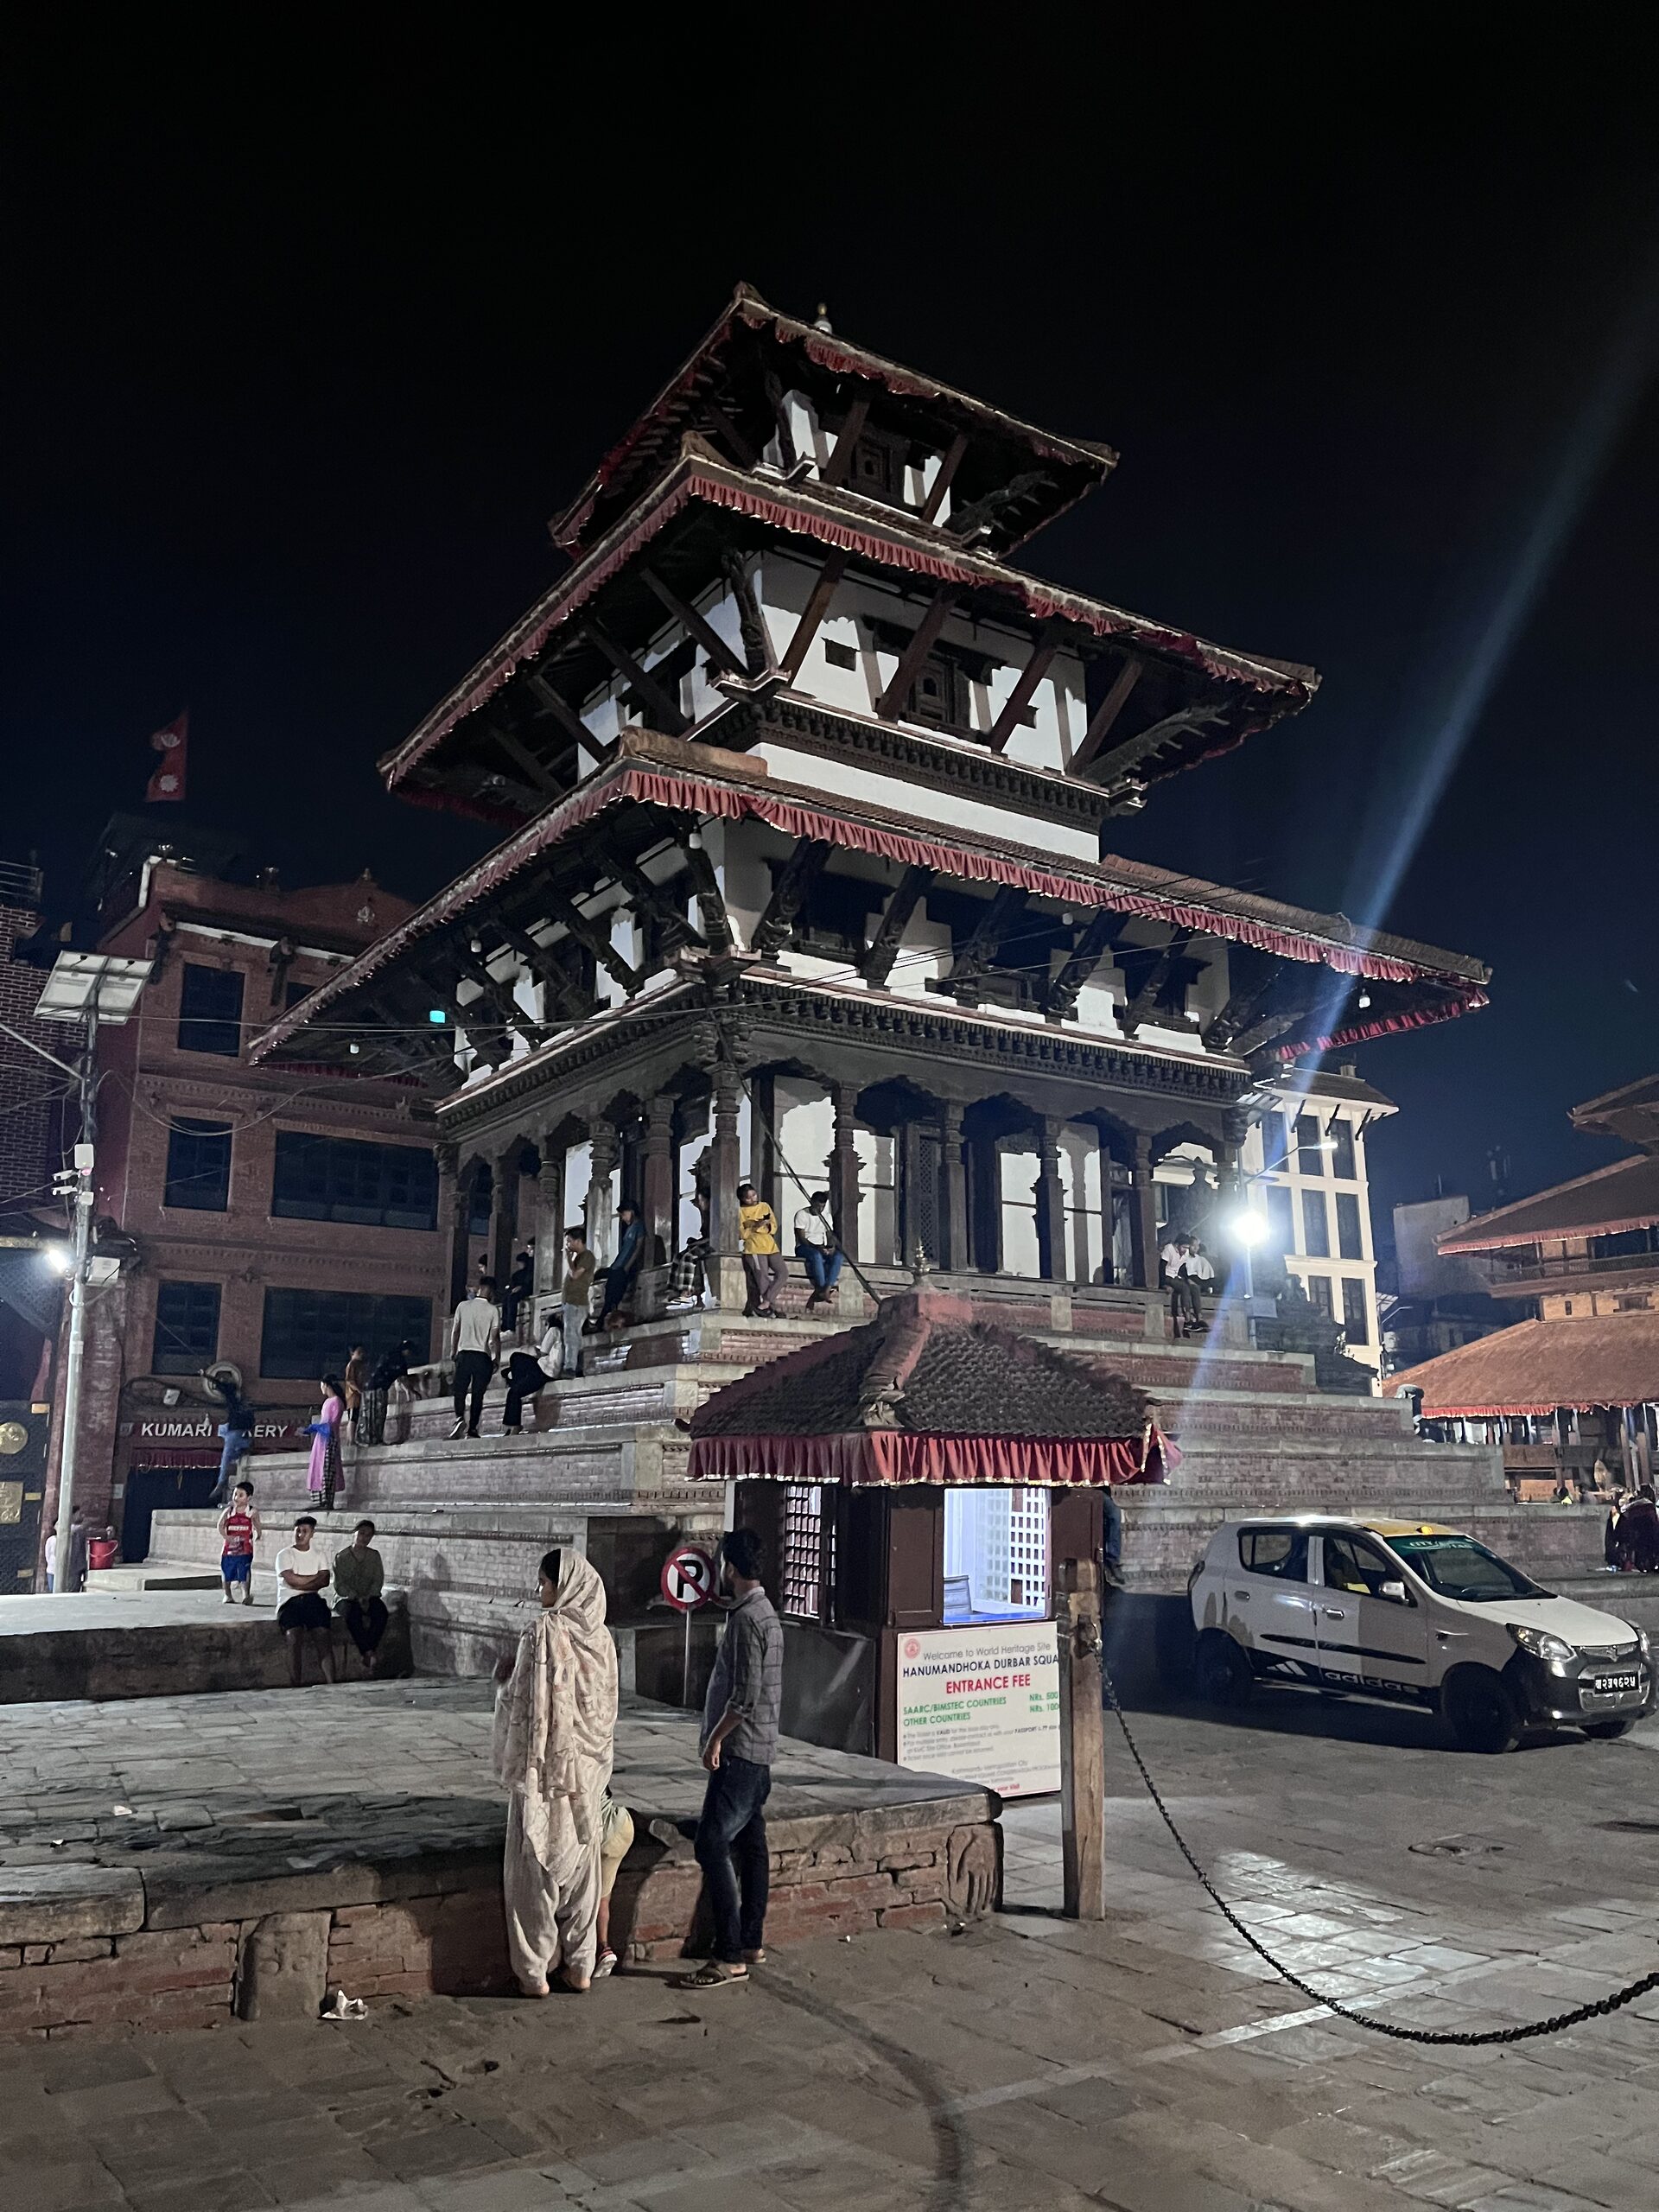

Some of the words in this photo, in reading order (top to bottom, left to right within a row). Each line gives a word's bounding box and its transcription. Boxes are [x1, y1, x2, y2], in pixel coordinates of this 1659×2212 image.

[141, 1422, 213, 1437] KUMARI
[677, 1560, 703, 1599] P
[924, 1649, 963, 1661] Welcome
[966, 1648, 974, 1657] to
[976, 1646, 999, 1657] World
[1001, 1643, 1035, 1656] Heritage
[1037, 1642, 1051, 1652] Site
[903, 1660, 991, 1677] HANUMANDHOKA
[995, 1656, 1031, 1669] DURBAR
[946, 1676, 1009, 1694] ENTRANCE
[1013, 1674, 1031, 1688] FEE
[1325, 1671, 1421, 1694] adidas
[903, 1701, 965, 1715] SAARC/BIMSTEC
[967, 1697, 1007, 1708] COUNTRIES
[903, 1715, 927, 1726] OTHER
[930, 1712, 971, 1724] COUNTRIES
